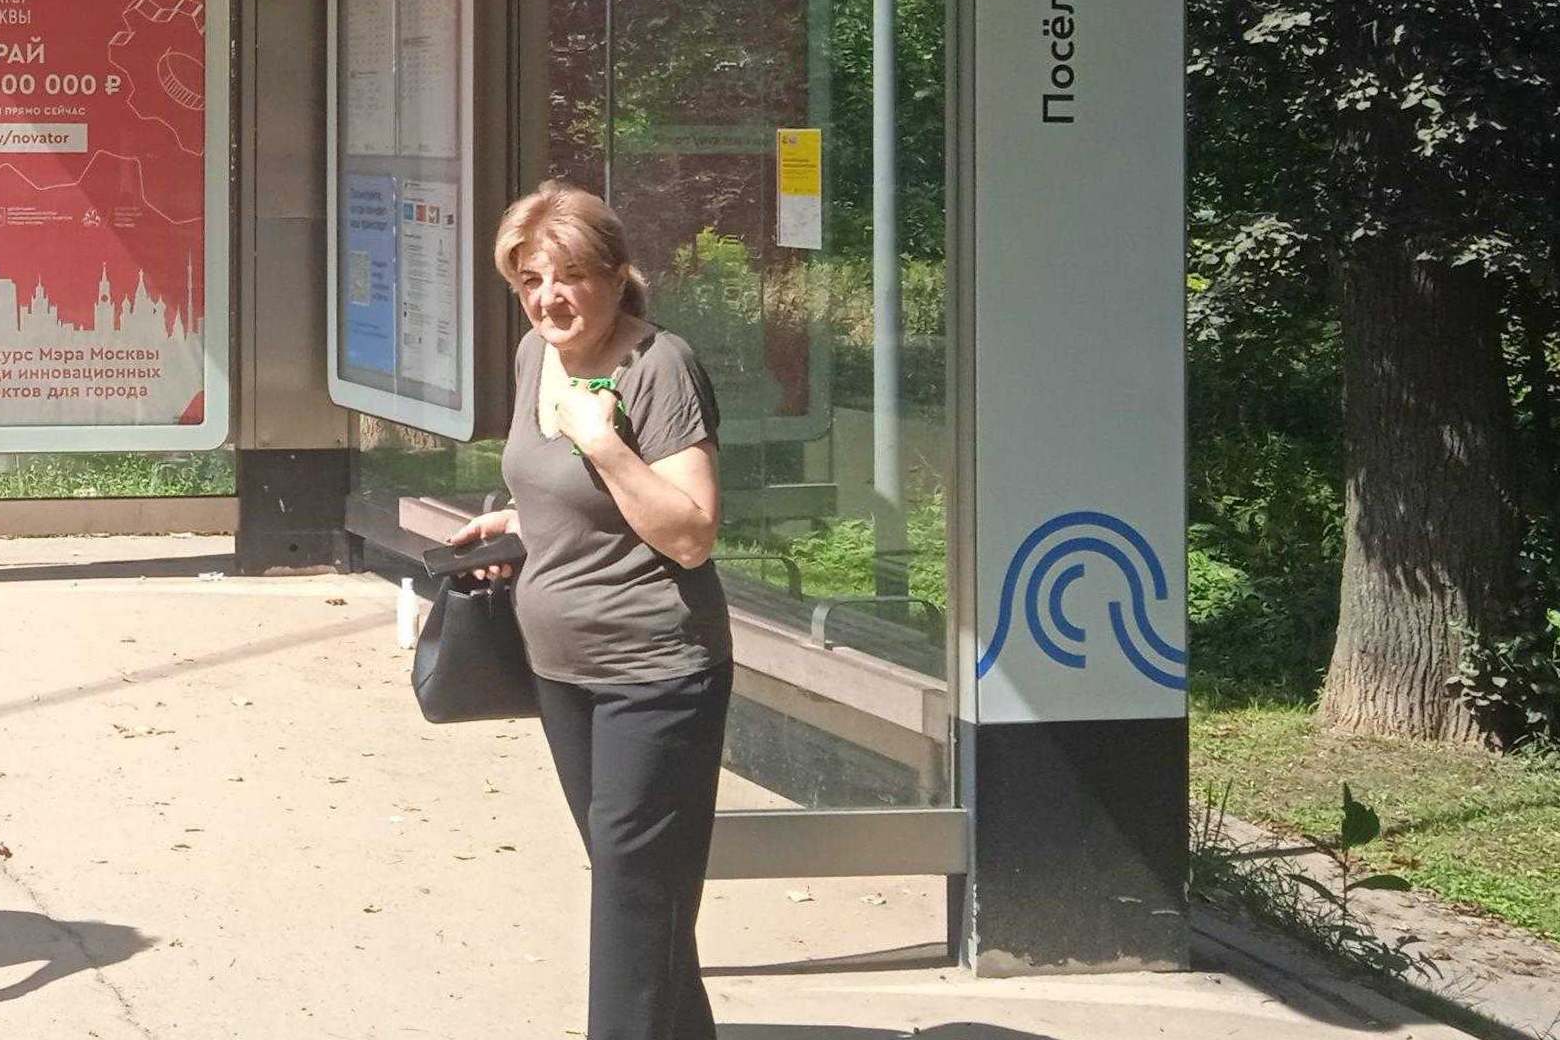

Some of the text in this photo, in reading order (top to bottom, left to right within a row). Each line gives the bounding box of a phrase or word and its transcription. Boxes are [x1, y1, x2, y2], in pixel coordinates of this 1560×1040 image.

[45, 73, 97, 96] 000
[4, 106, 41, 116] ПРЯМО
[44, 103, 87, 116] СЕЙЧАС
[39, 347, 84, 367] Мэра
[90, 347, 160, 362] Москвы
[18, 367, 161, 384] инновационных
[47, 386, 79, 400] для
[85, 387, 148, 403] города
